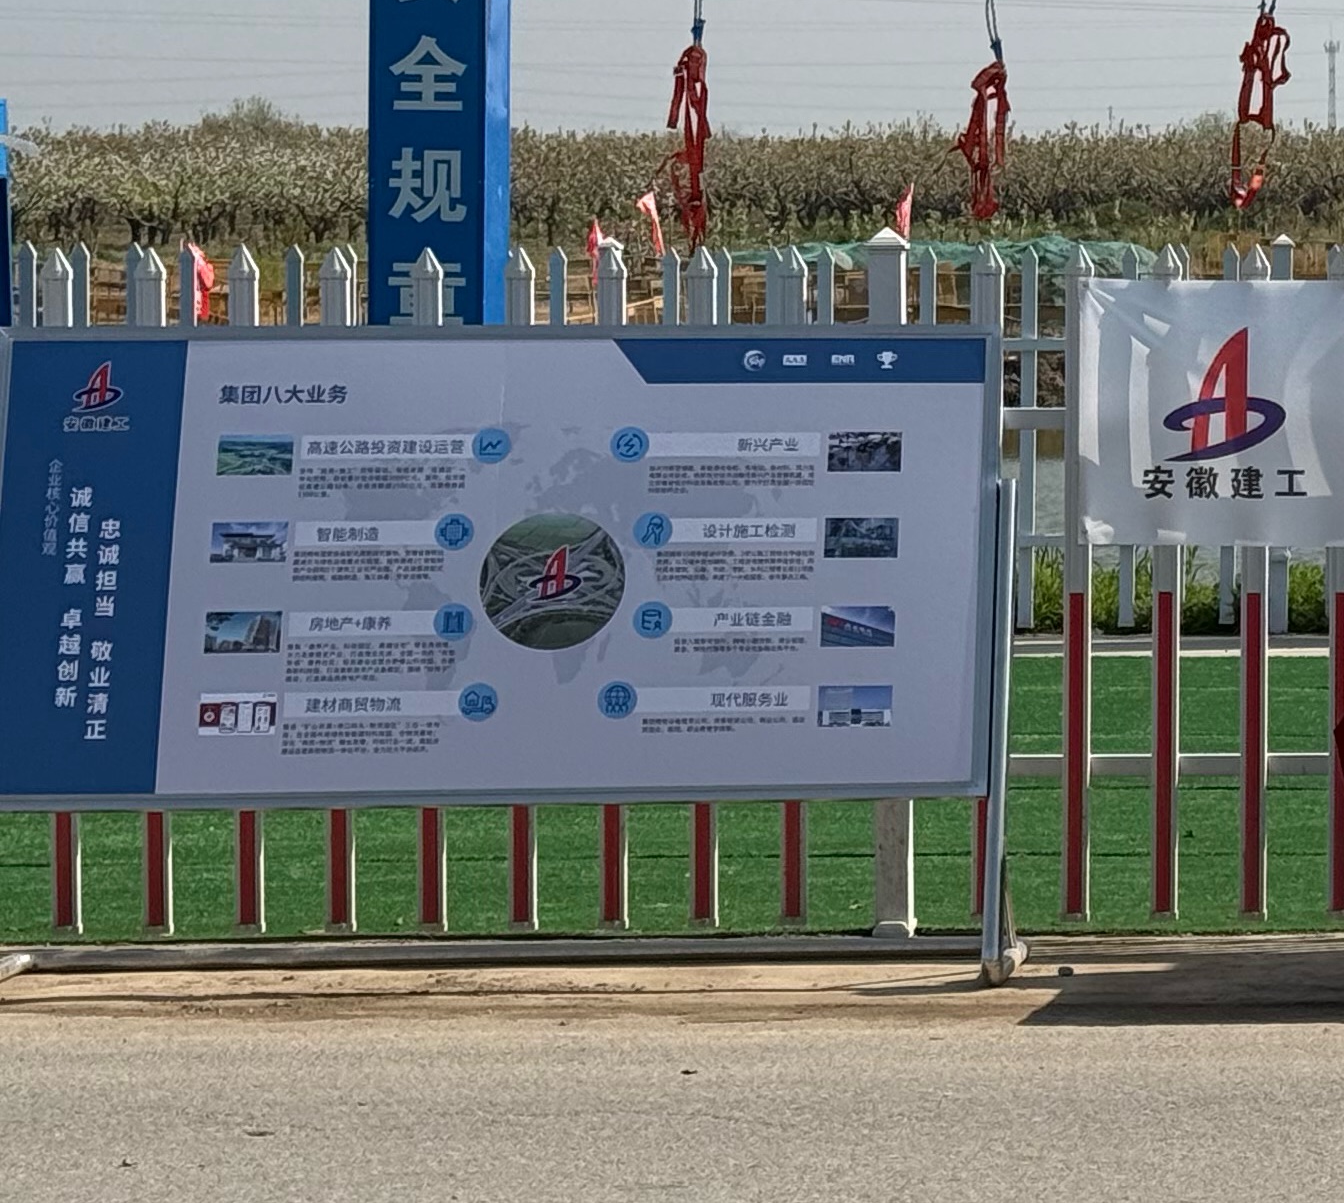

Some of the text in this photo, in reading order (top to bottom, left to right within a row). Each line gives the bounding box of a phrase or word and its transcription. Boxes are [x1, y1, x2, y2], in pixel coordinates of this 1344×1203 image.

[219, 385, 348, 405] 集团八大业务
[307, 439, 465, 455] 高速公路投资建设运营
[737, 438, 799, 453] 新兴产业
[1142, 466, 1307, 499] 安徽建工
[317, 527, 379, 542] 智能制造
[702, 524, 796, 539] 设计施工检测
[55, 486, 92, 707] 诚信共赢 卓越创新
[309, 616, 392, 631] 房地产+康养
[713, 613, 792, 628] 产业链金融
[84, 518, 121, 740] 忠诚担当 敬业清正
[304, 697, 401, 713] 建材商贸物流
[710, 693, 789, 708] 现代服务业
